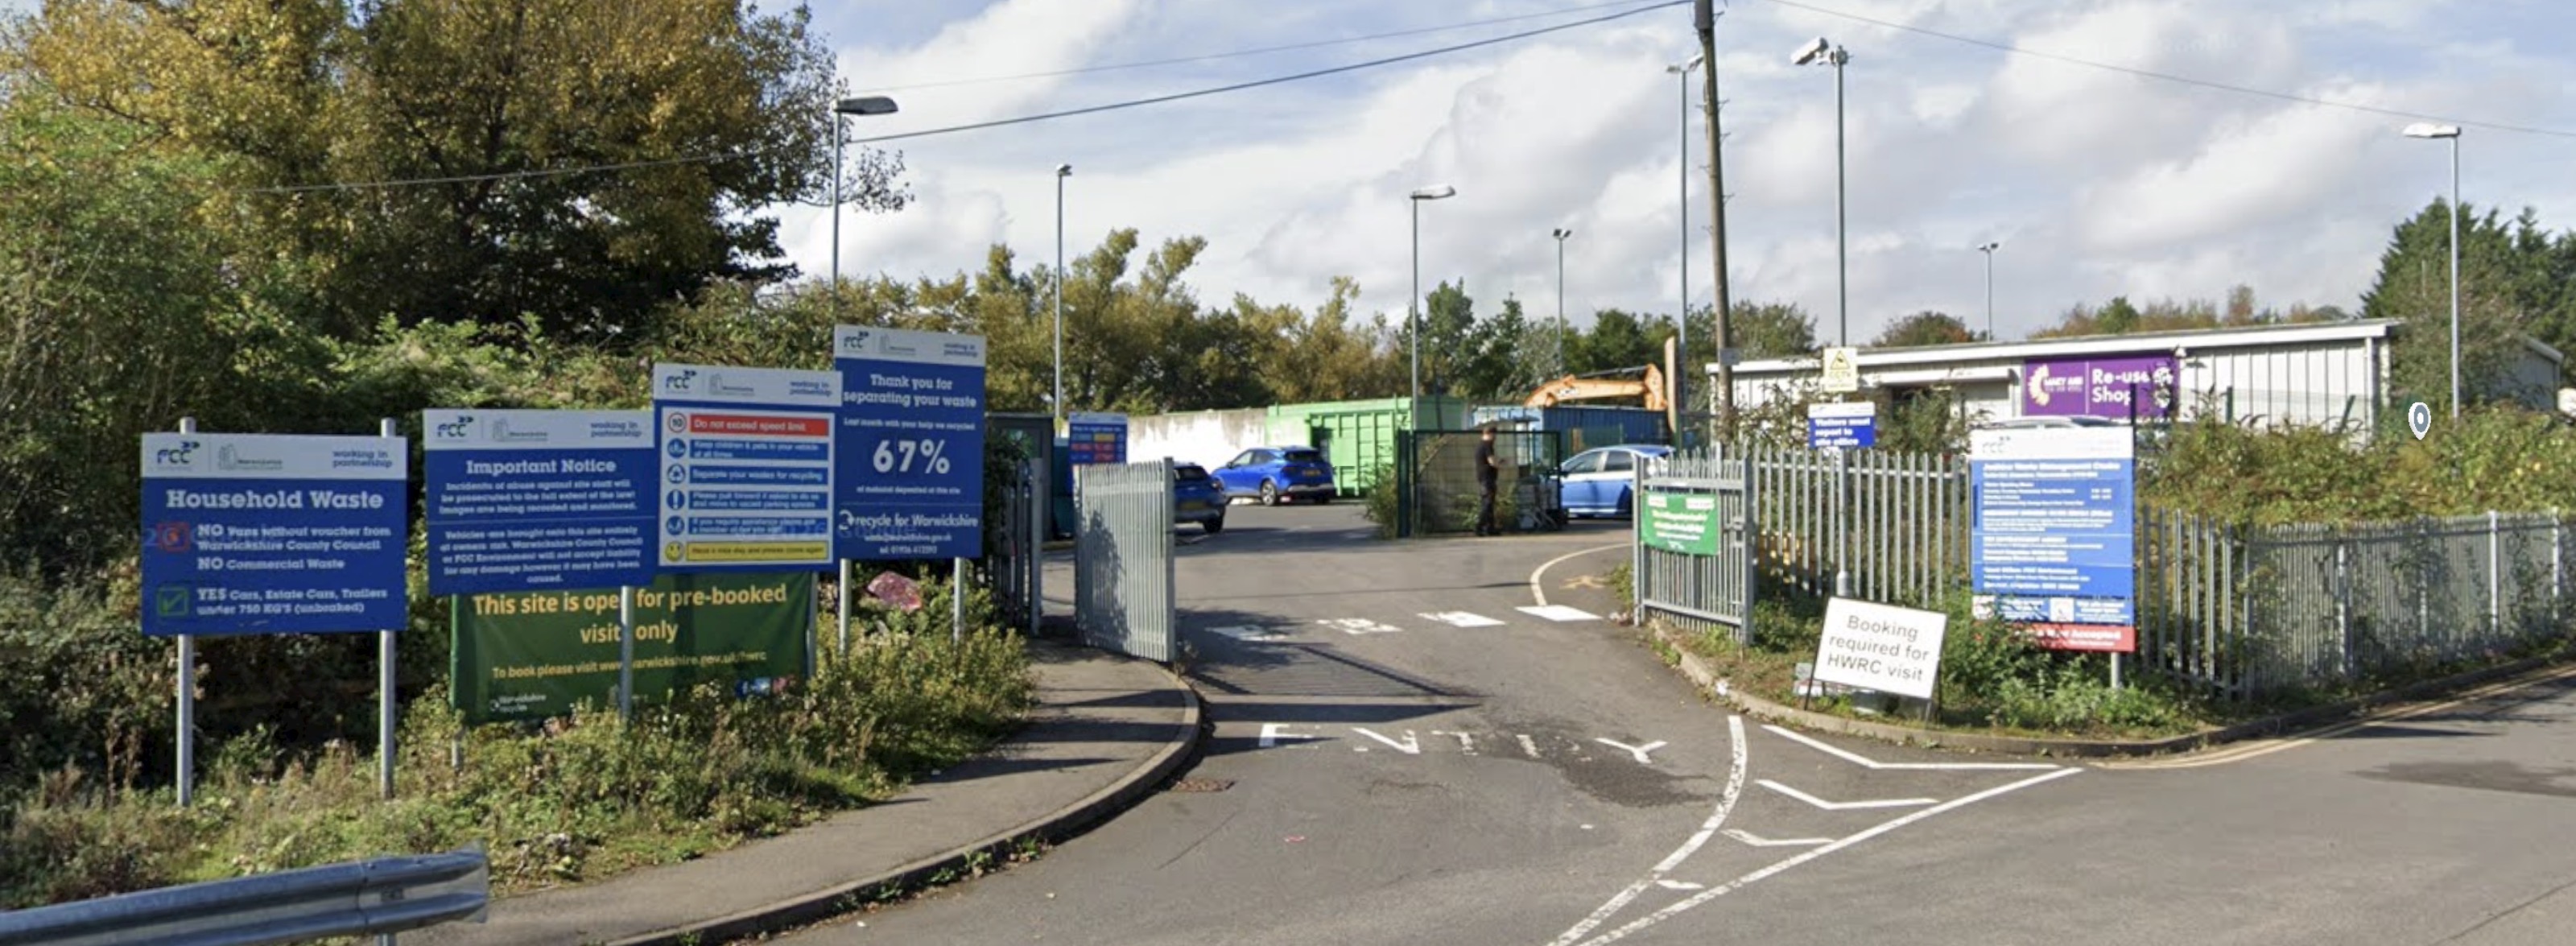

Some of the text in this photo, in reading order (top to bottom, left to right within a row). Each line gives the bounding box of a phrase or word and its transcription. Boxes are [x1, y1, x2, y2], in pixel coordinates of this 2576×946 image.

[870, 374, 952, 390] Thank you for
[2092, 369, 2150, 385] Re-use
[844, 391, 976, 408] separating your waste
[2092, 386, 2131, 405] Shop
[157, 448, 192, 465] FCC
[332, 457, 393, 469] partnership
[333, 449, 388, 460] working in
[873, 440, 950, 474] 67%
[466, 459, 617, 477] Important Notice
[166, 489, 383, 509] Household Waste
[854, 512, 979, 529] recycle for Warwickshire
[197, 523, 224, 537] NO
[260, 526, 308, 537] without
[310, 526, 361, 537] voucher
[363, 526, 392, 537] from
[197, 539, 382, 552] Warwickshire County Council
[197, 556, 345, 571] NO Commercial Waste
[197, 588, 389, 601] YES Cars, Estate Cars, Trailers
[473, 584, 787, 615] This site is ope for pre-booked
[238, 604, 261, 614] 750
[580, 619, 679, 643] visit only
[1847, 615, 1918, 642] Booking
[1828, 635, 1930, 661] required for
[493, 667, 506, 680] To
[508, 665, 536, 679] book
[537, 664, 574, 680] please
[575, 663, 598, 675] visit
[1827, 653, 1924, 681] HWRC visit
